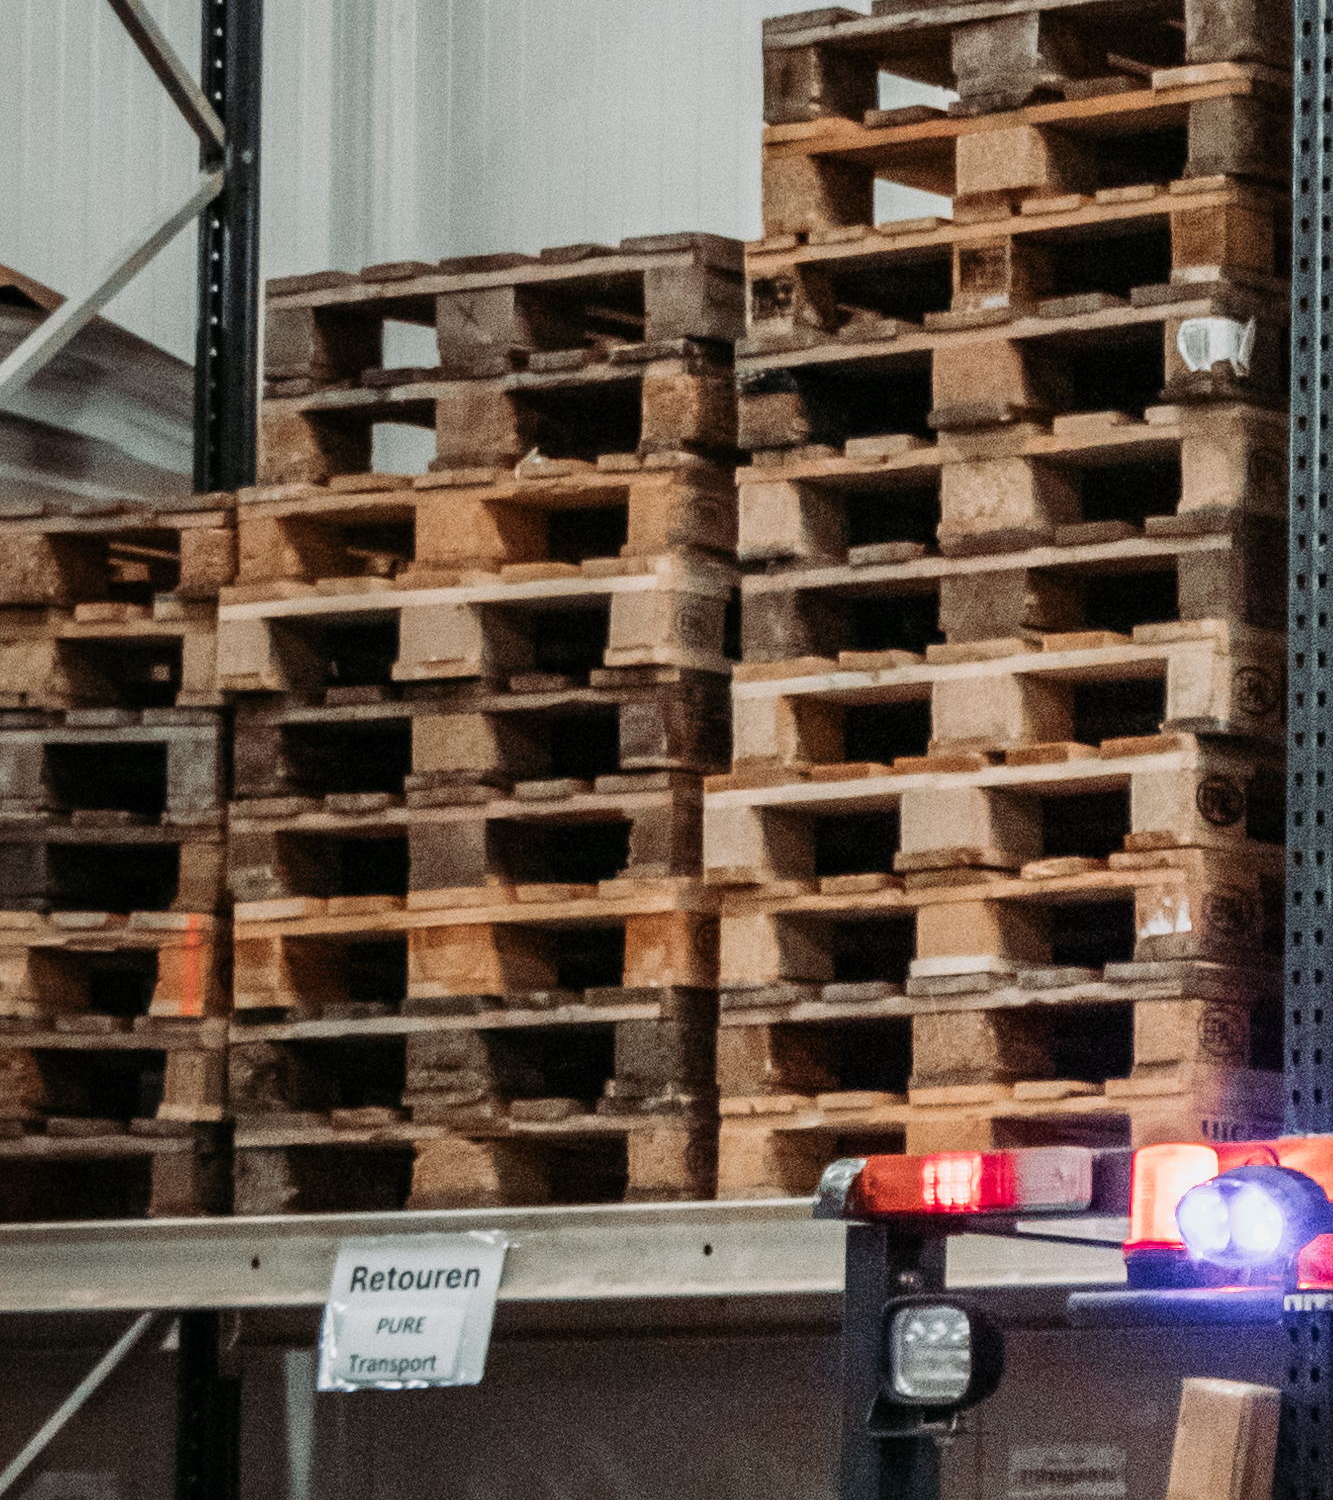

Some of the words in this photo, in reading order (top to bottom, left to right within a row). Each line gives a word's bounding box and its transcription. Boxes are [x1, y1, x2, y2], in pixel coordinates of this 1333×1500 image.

[350, 1266, 481, 1292] Retouren
[375, 1316, 427, 1334] PURE
[350, 1354, 437, 1376] Transport
